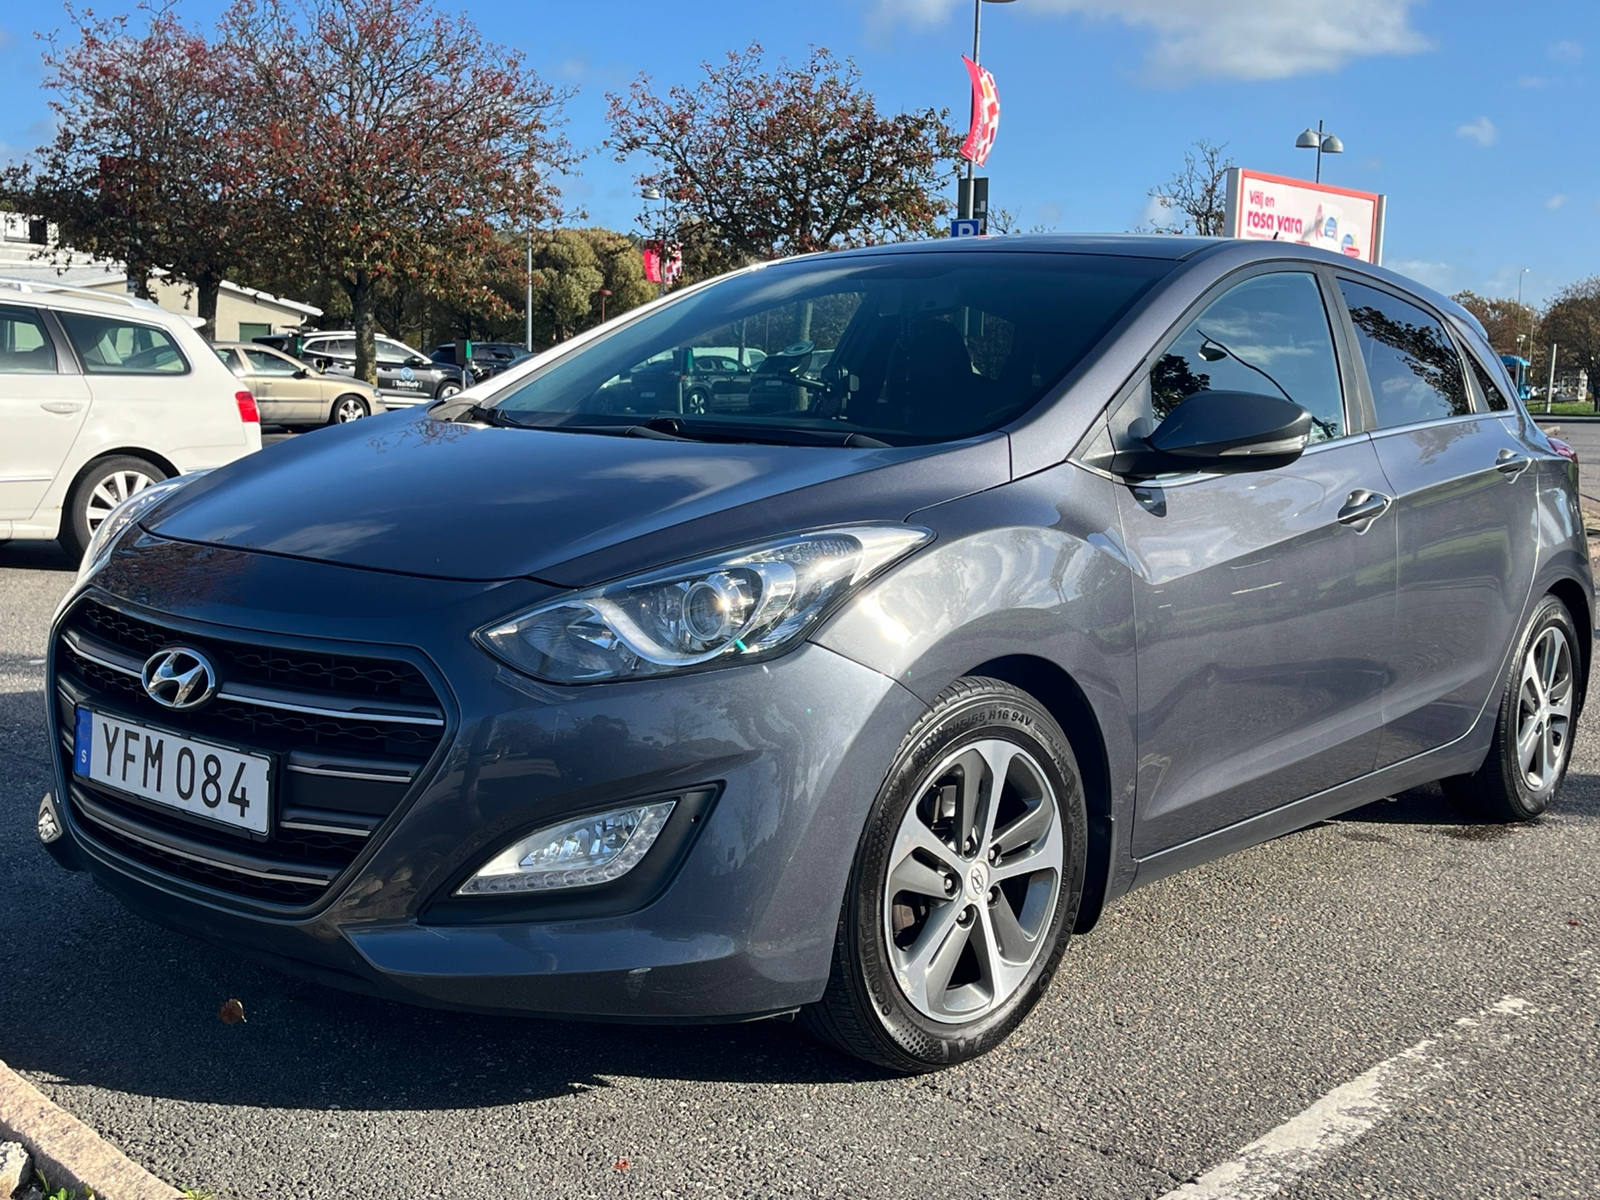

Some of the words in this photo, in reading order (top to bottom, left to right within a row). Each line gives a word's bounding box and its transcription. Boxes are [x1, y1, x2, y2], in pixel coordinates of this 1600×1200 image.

[1249, 190, 1264, 208] Välj
[1265, 197, 1275, 207] en
[958, 223, 974, 237] P
[1247, 210, 1274, 230] rosa
[1277, 215, 1303, 234] vara
[988, 709, 1009, 720] R16
[1011, 712, 1033, 726] 94V
[81, 750, 87, 763] S
[103, 723, 164, 792] YFM
[176, 747, 250, 818] 084
